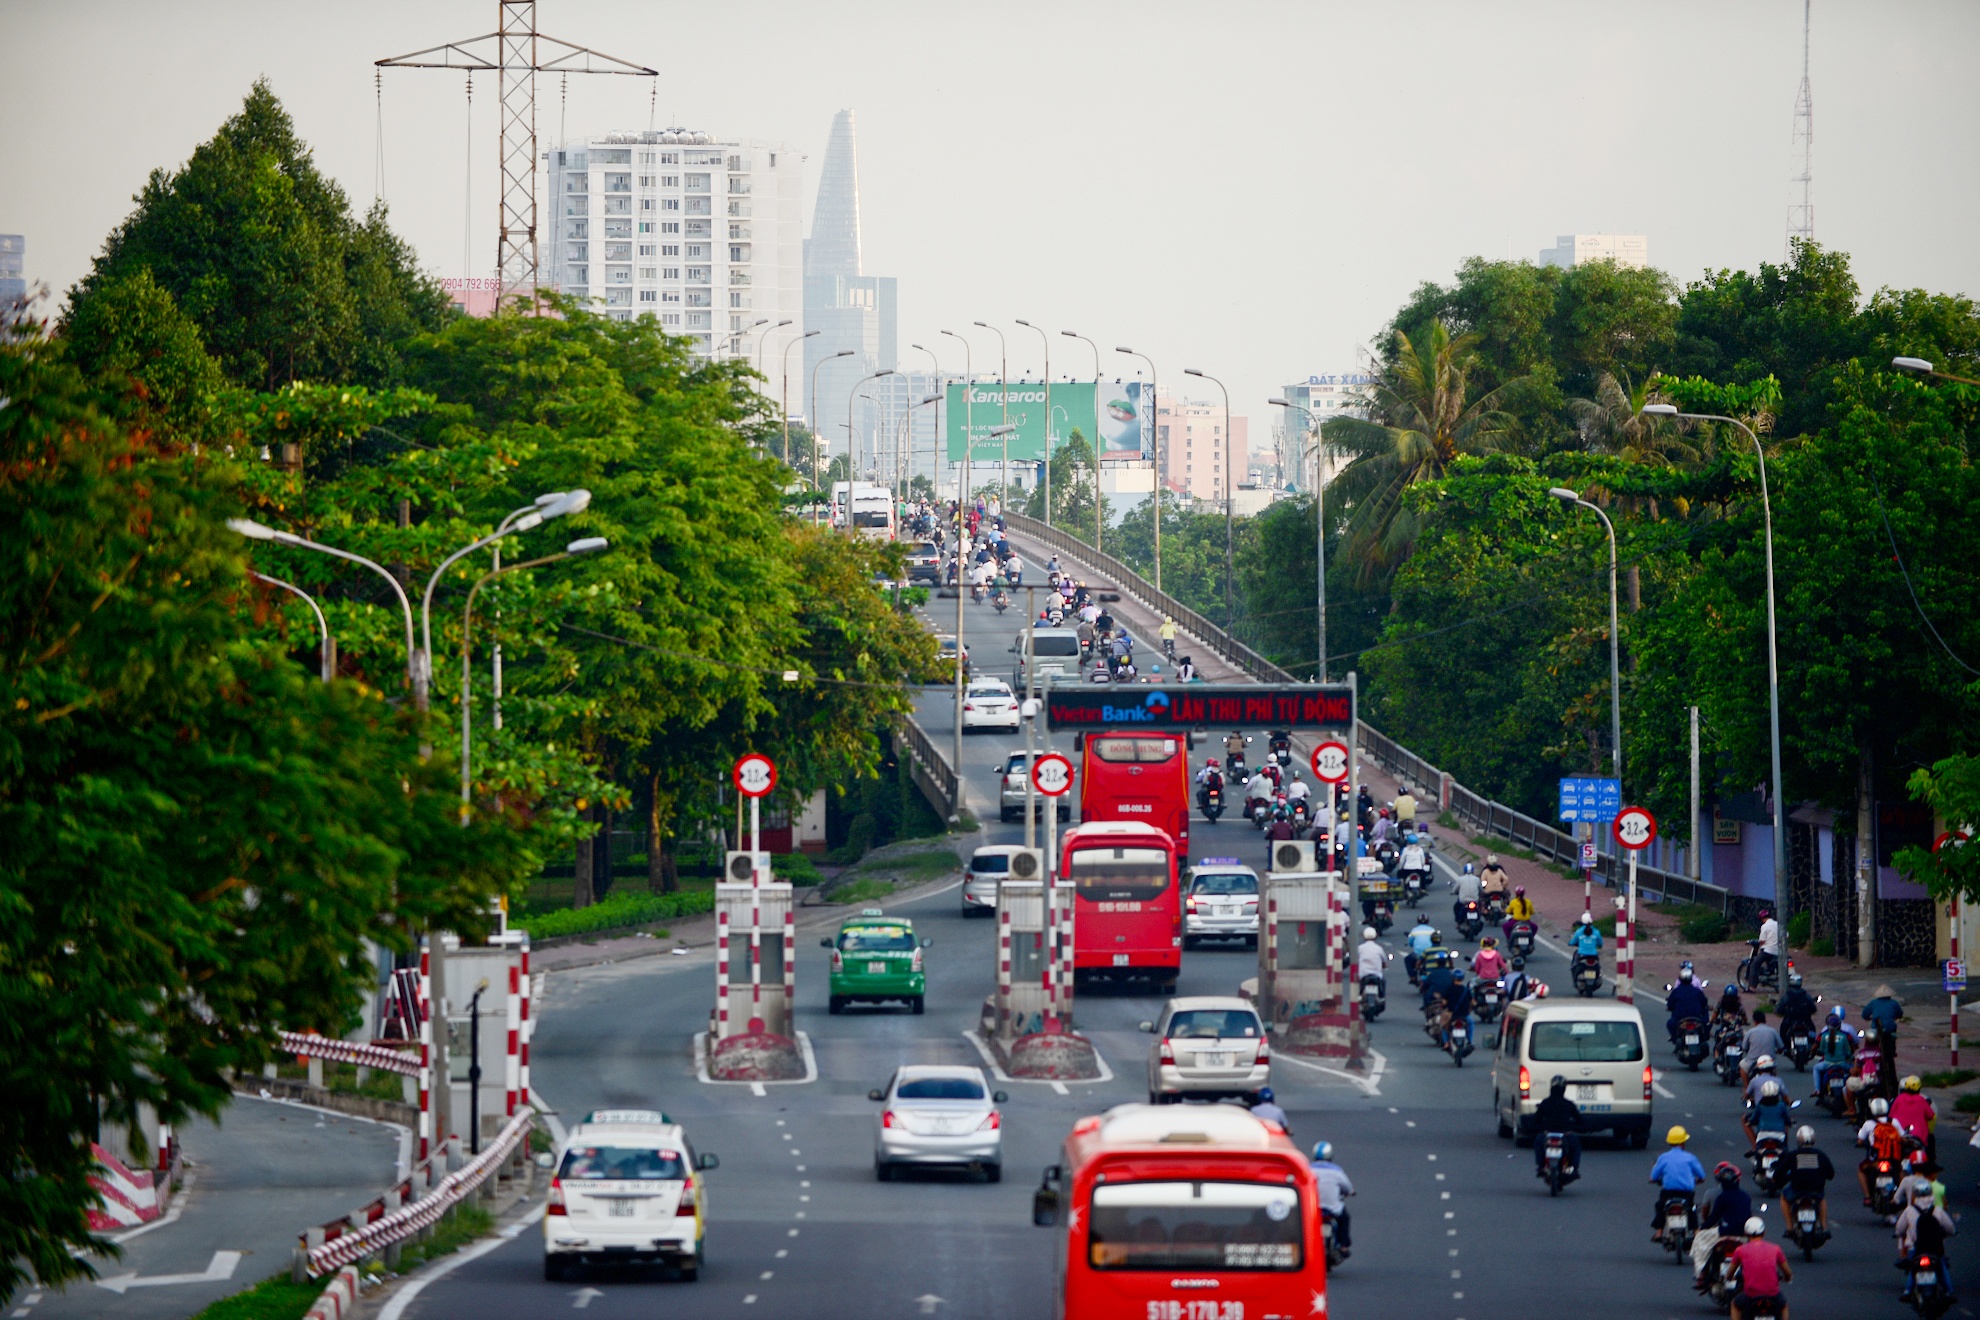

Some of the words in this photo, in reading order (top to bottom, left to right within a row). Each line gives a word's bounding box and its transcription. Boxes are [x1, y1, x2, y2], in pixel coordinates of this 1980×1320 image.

[441, 278, 463, 290] 0904
[466, 278, 482, 290] 792
[1309, 371, 1336, 385] ĐẤT
[969, 387, 1046, 406] Kangaroo
[1051, 705, 1147, 723] VietinBank
[1171, 692, 1205, 722] LÀN
[1208, 697, 1241, 722] THU
[1245, 692, 1274, 722] PHÍ
[1277, 693, 1301, 725] TỰ
[1303, 692, 1350, 725] ĐỘNG
[1584, 845, 1593, 857] 5
[1948, 961, 1960, 977] 5
